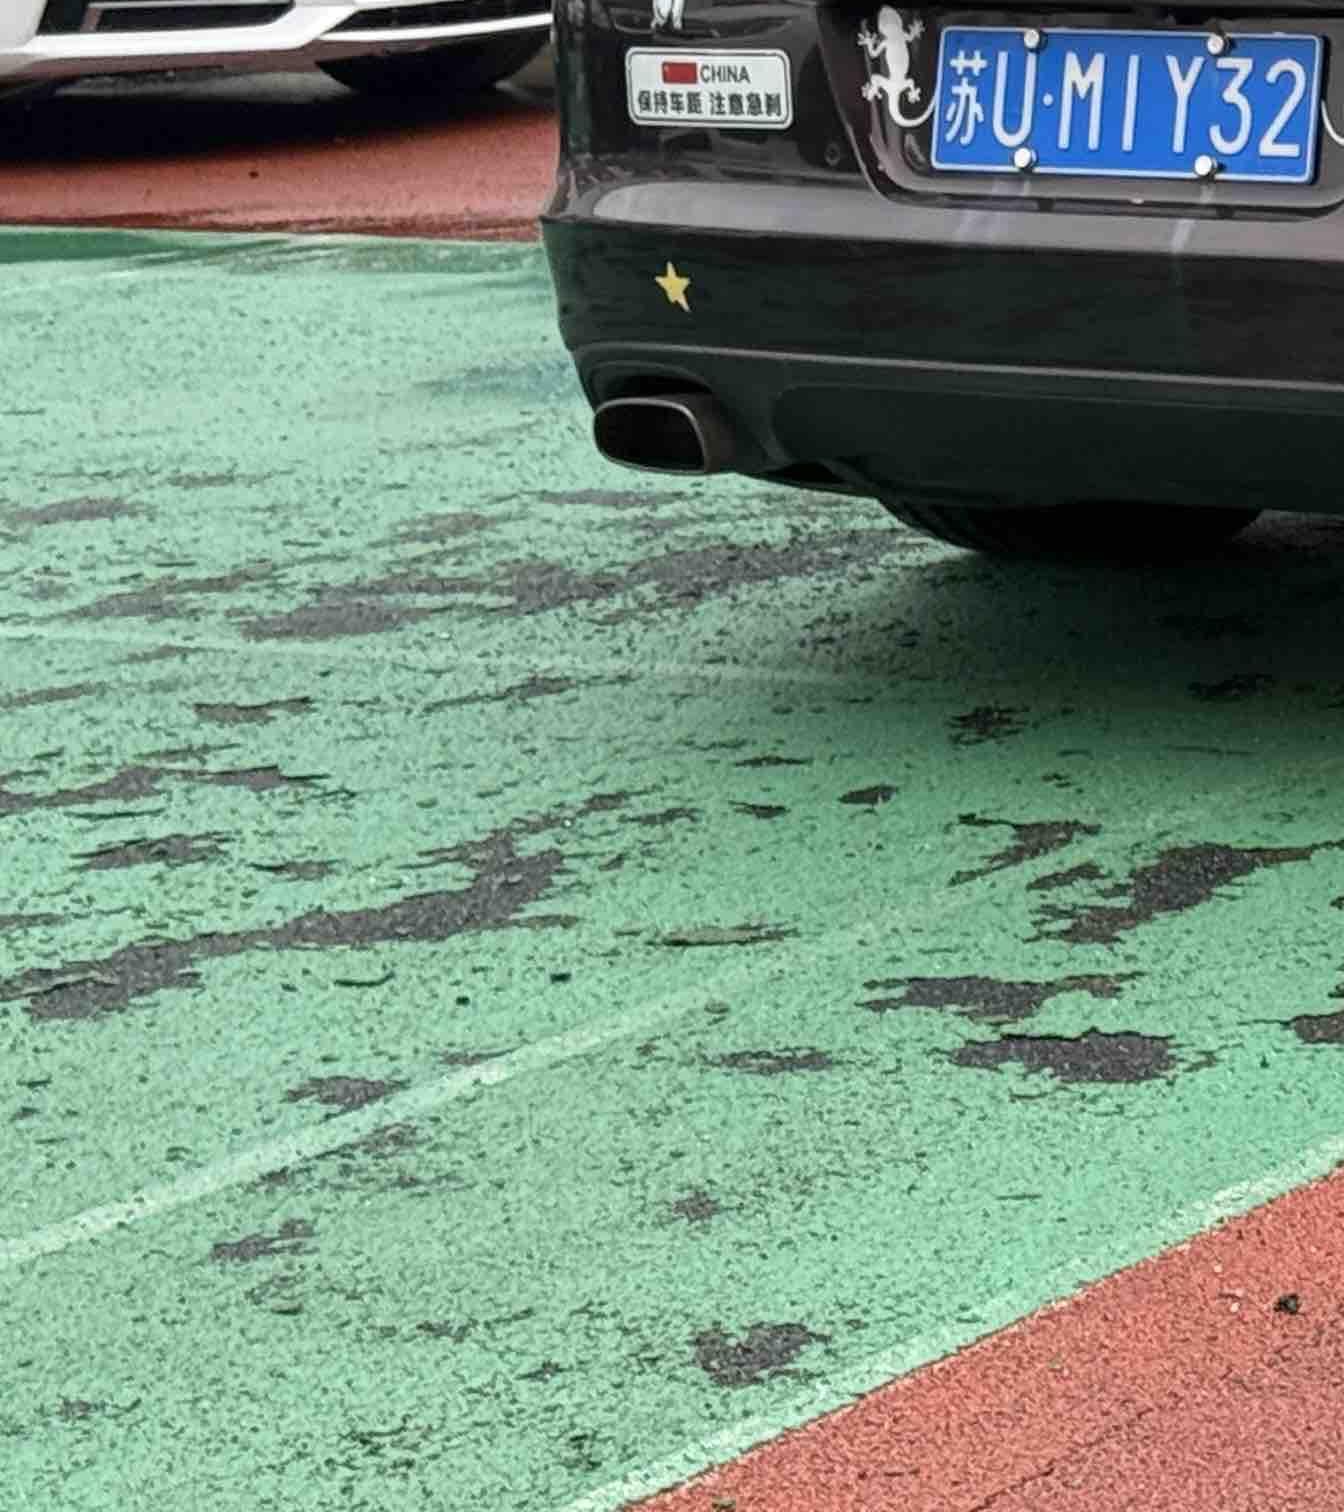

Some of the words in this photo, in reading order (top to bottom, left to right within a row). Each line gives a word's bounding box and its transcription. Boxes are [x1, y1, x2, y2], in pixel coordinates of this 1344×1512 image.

[700, 64, 751, 84] CHINA
[637, 90, 704, 115] 保持车距
[709, 91, 782, 117] 注意急刹
